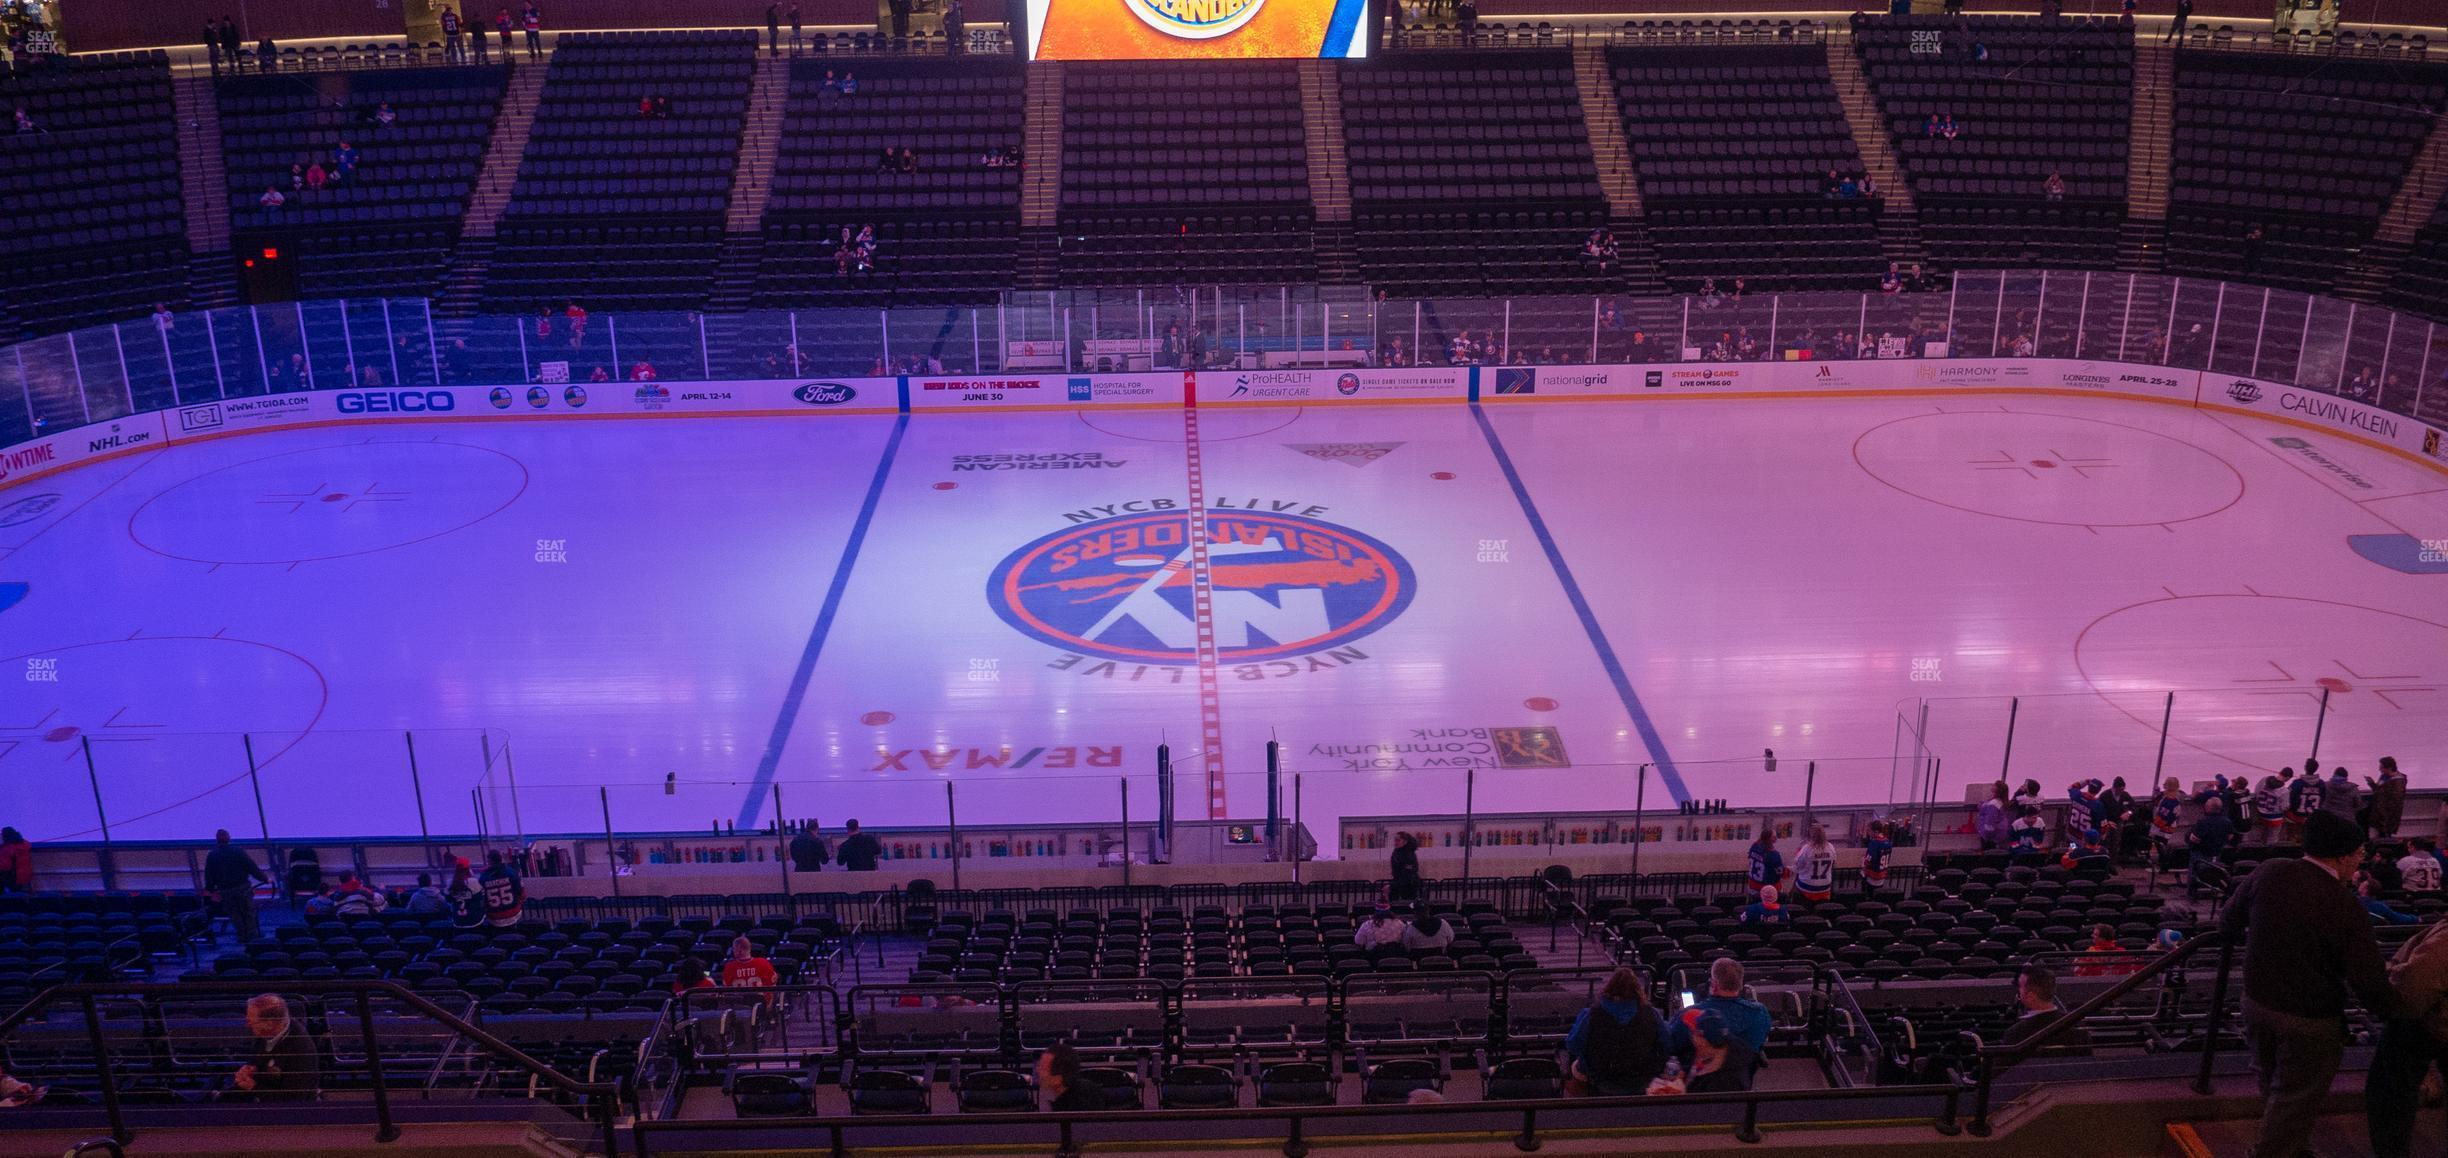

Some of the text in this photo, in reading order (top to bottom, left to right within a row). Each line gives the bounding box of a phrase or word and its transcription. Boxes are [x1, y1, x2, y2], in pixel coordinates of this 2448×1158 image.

[1252, 373, 1311, 384] ProHEALTH
[1940, 367, 1998, 376] HARMONY
[971, 381, 987, 389] ON
[989, 381, 1005, 389] THE
[1542, 373, 1608, 386] nationalgrid
[2063, 374, 2111, 384] LONGINES
[2119, 375, 2178, 387] APRIL 25-28
[803, 384, 847, 402] Ford
[1070, 385, 1089, 393] HSS
[1252, 387, 1311, 397] URGENT CARE
[336, 390, 455, 414] GEICO
[681, 393, 708, 401] APRIL
[709, 392, 732, 400] 12-14
[962, 393, 989, 401] JUNE
[184, 408, 217, 427] TGI
[2280, 393, 2398, 439] CALVIN KLEIN
[89, 432, 149, 453] NHL.COM
[952, 452, 1103, 463] EXPRESS
[952, 460, 1127, 472] AMERICAN
[1062, 497, 1330, 523] NYCB LIVE
[1051, 521, 1357, 573] ISLANDERS
[1046, 645, 1371, 684] NYCB LIVE
[1410, 727, 1488, 740] Bank
[1308, 742, 1491, 758] Community
[871, 745, 1123, 771] RE/MAX
[1344, 756, 1498, 773] New York
[2070, 808, 2092, 832] 25
[1810, 860, 1832, 880] 17
[487, 884, 514, 908] 55
[736, 967, 756, 977] OTTO
